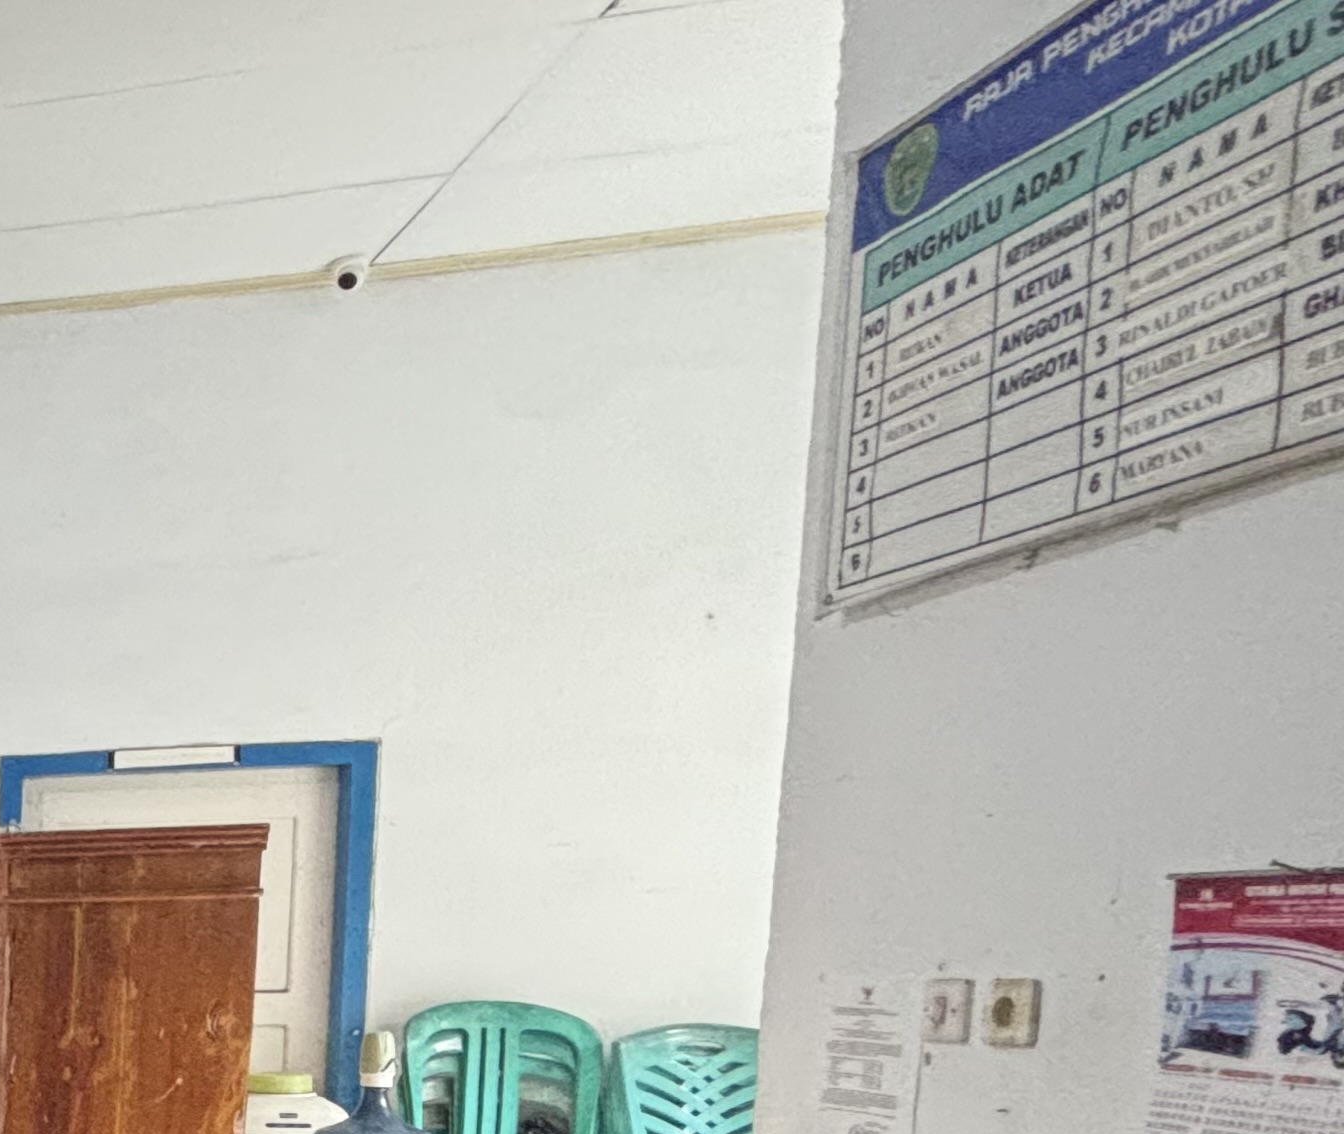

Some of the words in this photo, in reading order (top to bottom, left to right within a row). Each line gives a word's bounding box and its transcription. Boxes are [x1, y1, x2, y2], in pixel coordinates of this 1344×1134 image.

[1120, 18, 1317, 152] PENGHULU
[1099, 187, 1129, 219] NO
[878, 194, 1004, 287] PENGHULU
[1011, 148, 1086, 214] ADAT
[1103, 241, 1113, 263] 1
[1099, 287, 1113, 311] 2
[863, 318, 885, 343] NO
[865, 360, 875, 379] 1
[1013, 262, 1073, 308] KETUA
[1095, 334, 1108, 358] 3
[862, 399, 873, 419] 2
[998, 302, 1084, 357] ANGGOTA
[1095, 379, 1107, 401] 4
[859, 438, 869, 457] 3
[996, 348, 1080, 400] ANGGOTA
[1093, 425, 1105, 449] 5
[855, 476, 866, 493] 4
[1088, 472, 1101, 494] 6
